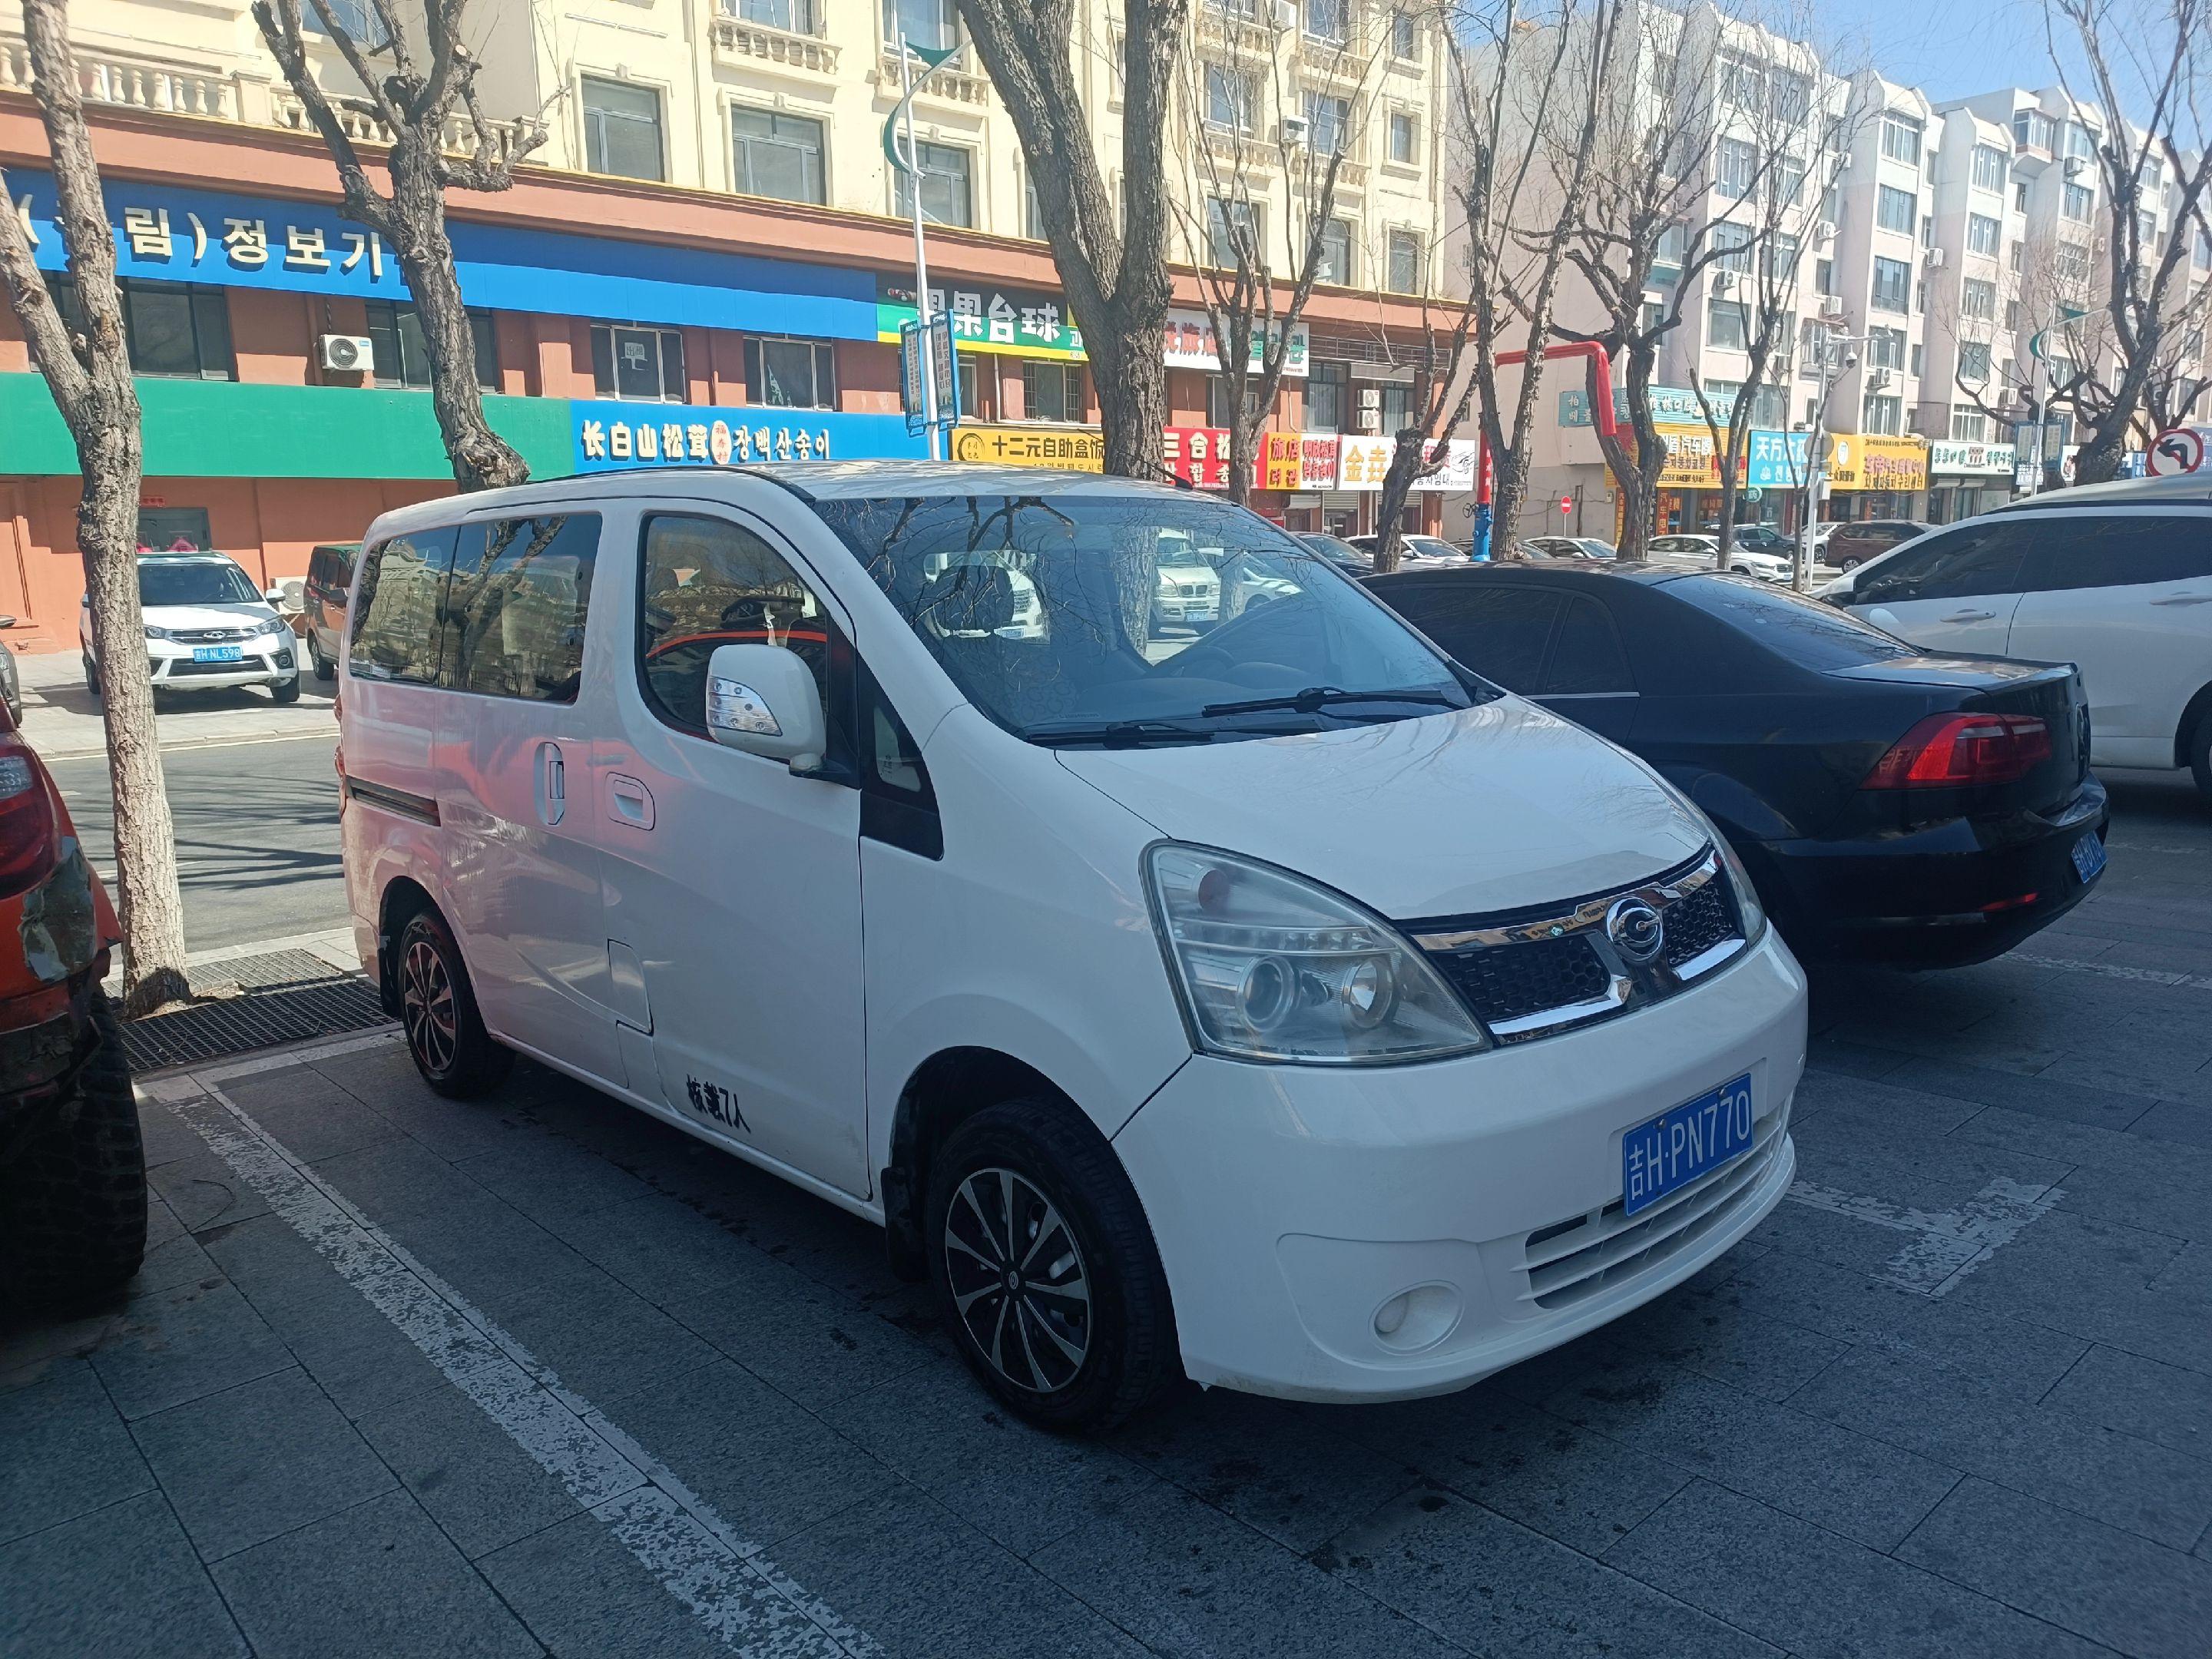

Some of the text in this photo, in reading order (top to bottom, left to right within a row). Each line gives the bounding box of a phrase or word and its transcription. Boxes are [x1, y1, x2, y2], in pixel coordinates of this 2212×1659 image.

[583, 420, 708, 459] 长白山松茸
[733, 426, 830, 461] 장백산송이
[992, 435, 1104, 459] 十二元自助盒饭
[1164, 432, 1259, 461] 三合松
[1272, 438, 1300, 462] 旅店
[1412, 472, 1450, 486] 동차임대
